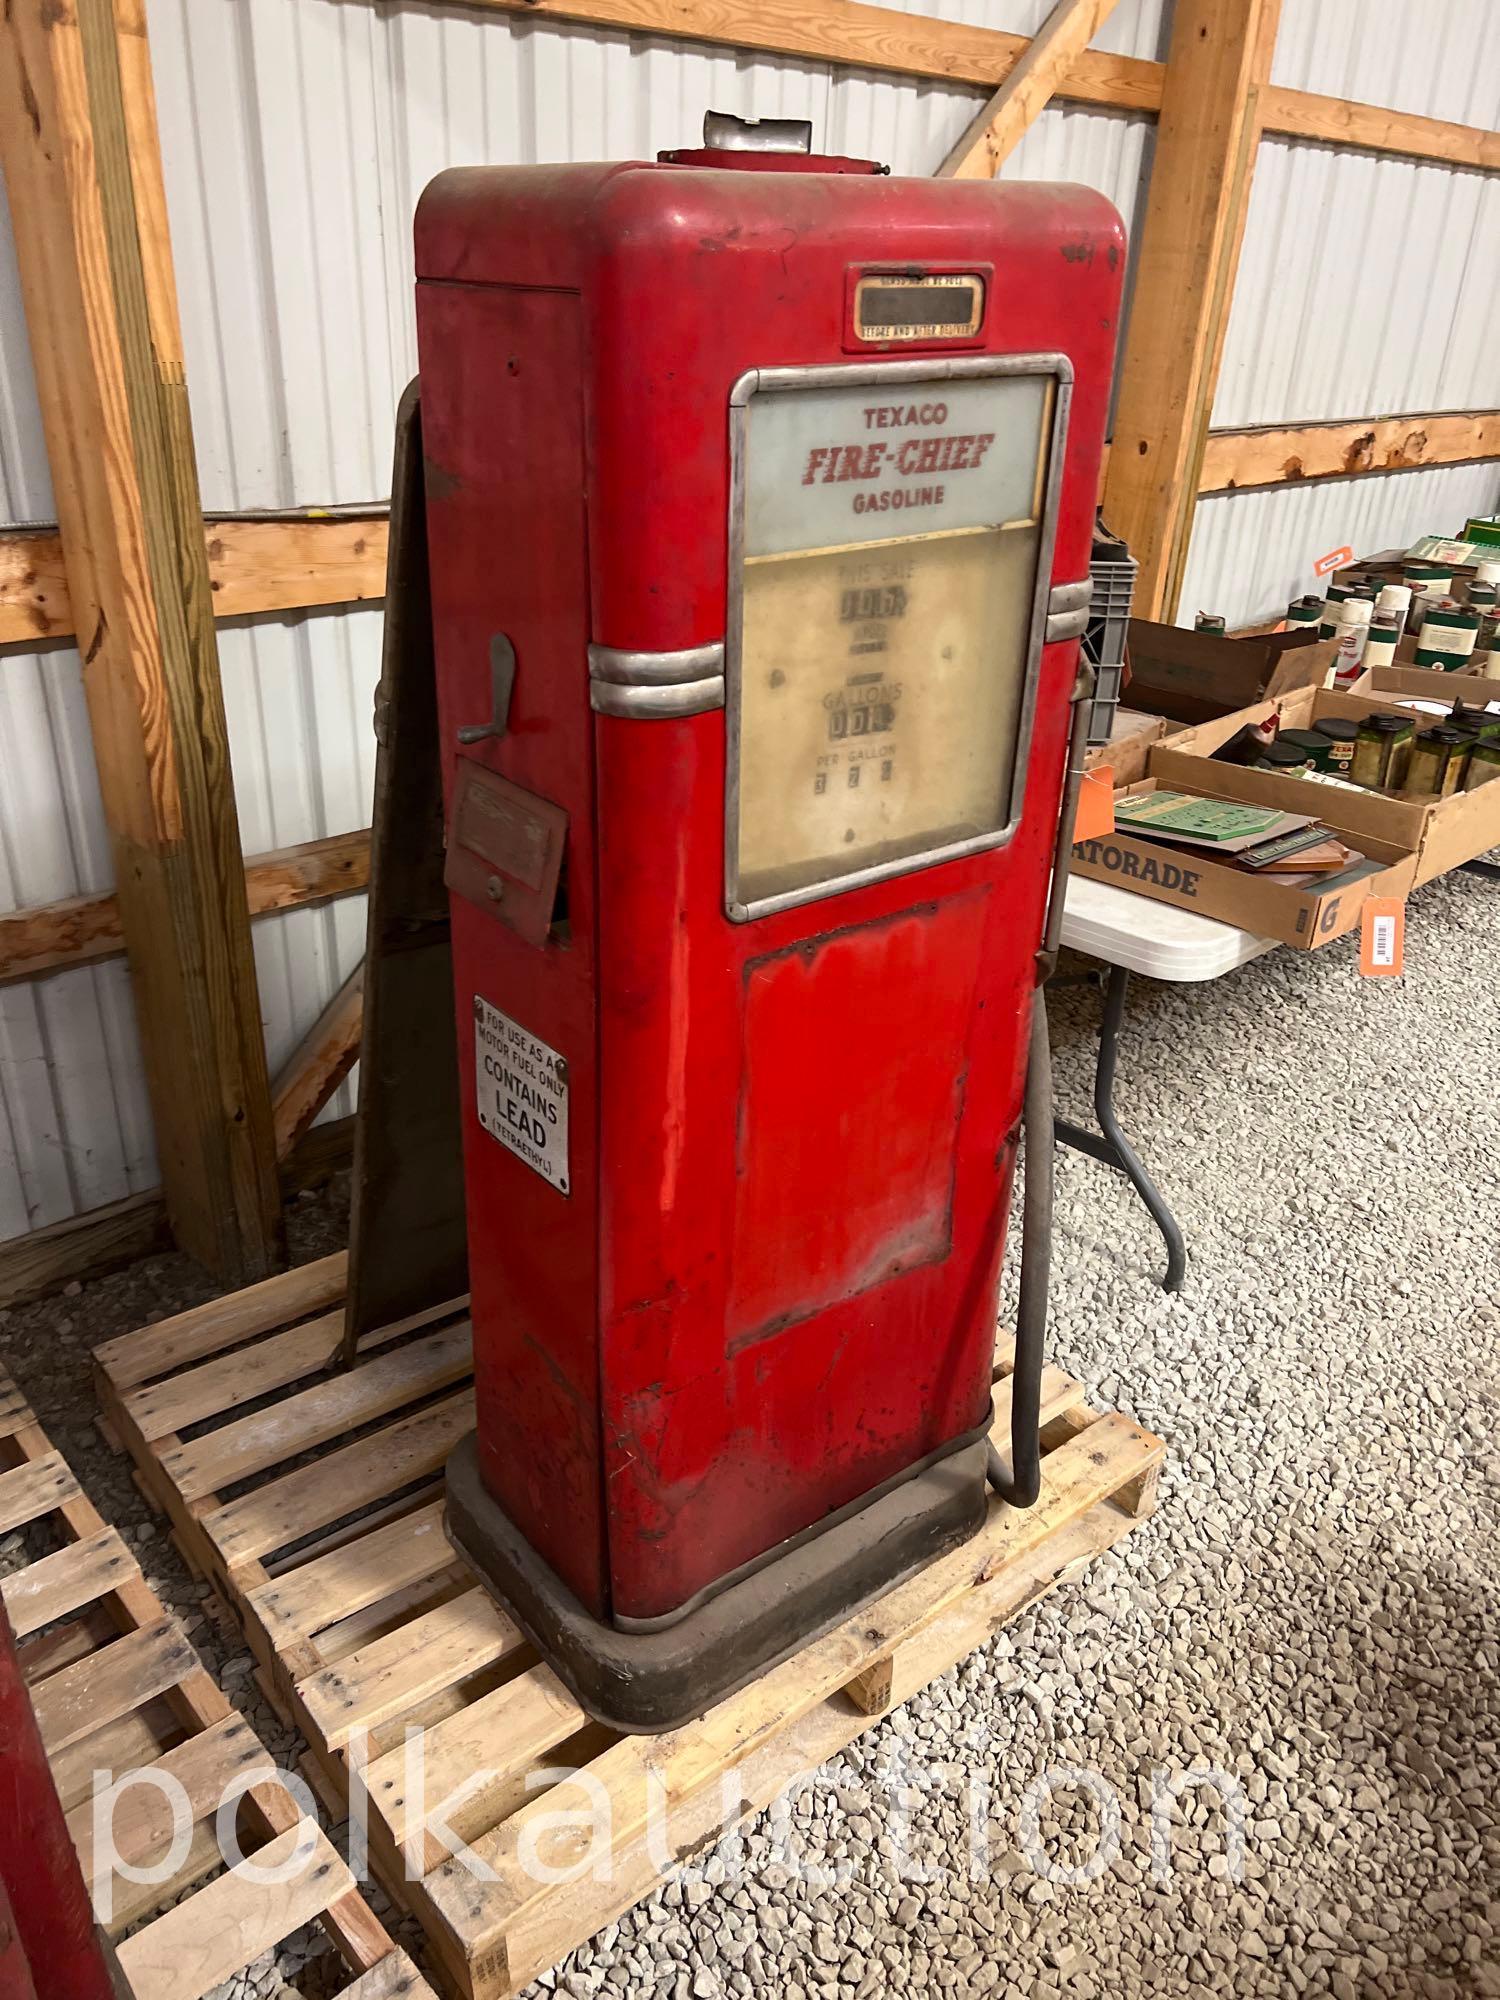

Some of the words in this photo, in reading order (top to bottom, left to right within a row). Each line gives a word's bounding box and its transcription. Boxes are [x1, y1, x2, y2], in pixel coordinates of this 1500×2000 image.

[862, 326, 890, 338] BEFORE
[894, 326, 910, 337] AND
[914, 325, 937, 336] AFTER
[863, 402, 949, 430] TEXACO
[801, 432, 996, 487] FIRE-CHIEF
[852, 485, 945, 515] GASOLINE
[823, 682, 903, 711] GALLONS
[816, 754, 839, 768] PER
[847, 744, 897, 763] GALLON
[1071, 839, 1203, 897] ATORADE
[478, 1024, 510, 1058] MOTOR
[512, 1050, 536, 1079] FUEL
[539, 1070, 565, 1099] ONLY
[487, 1012, 505, 1033] FOR
[507, 1028, 526, 1048] USE
[529, 1048, 543, 1063] AS
[546, 1055, 555, 1072] A
[484, 1054, 558, 1125] CONTAINS
[492, 1117, 552, 1176] (TETRAETHYL)
[495, 1089, 547, 1149] LEAD
